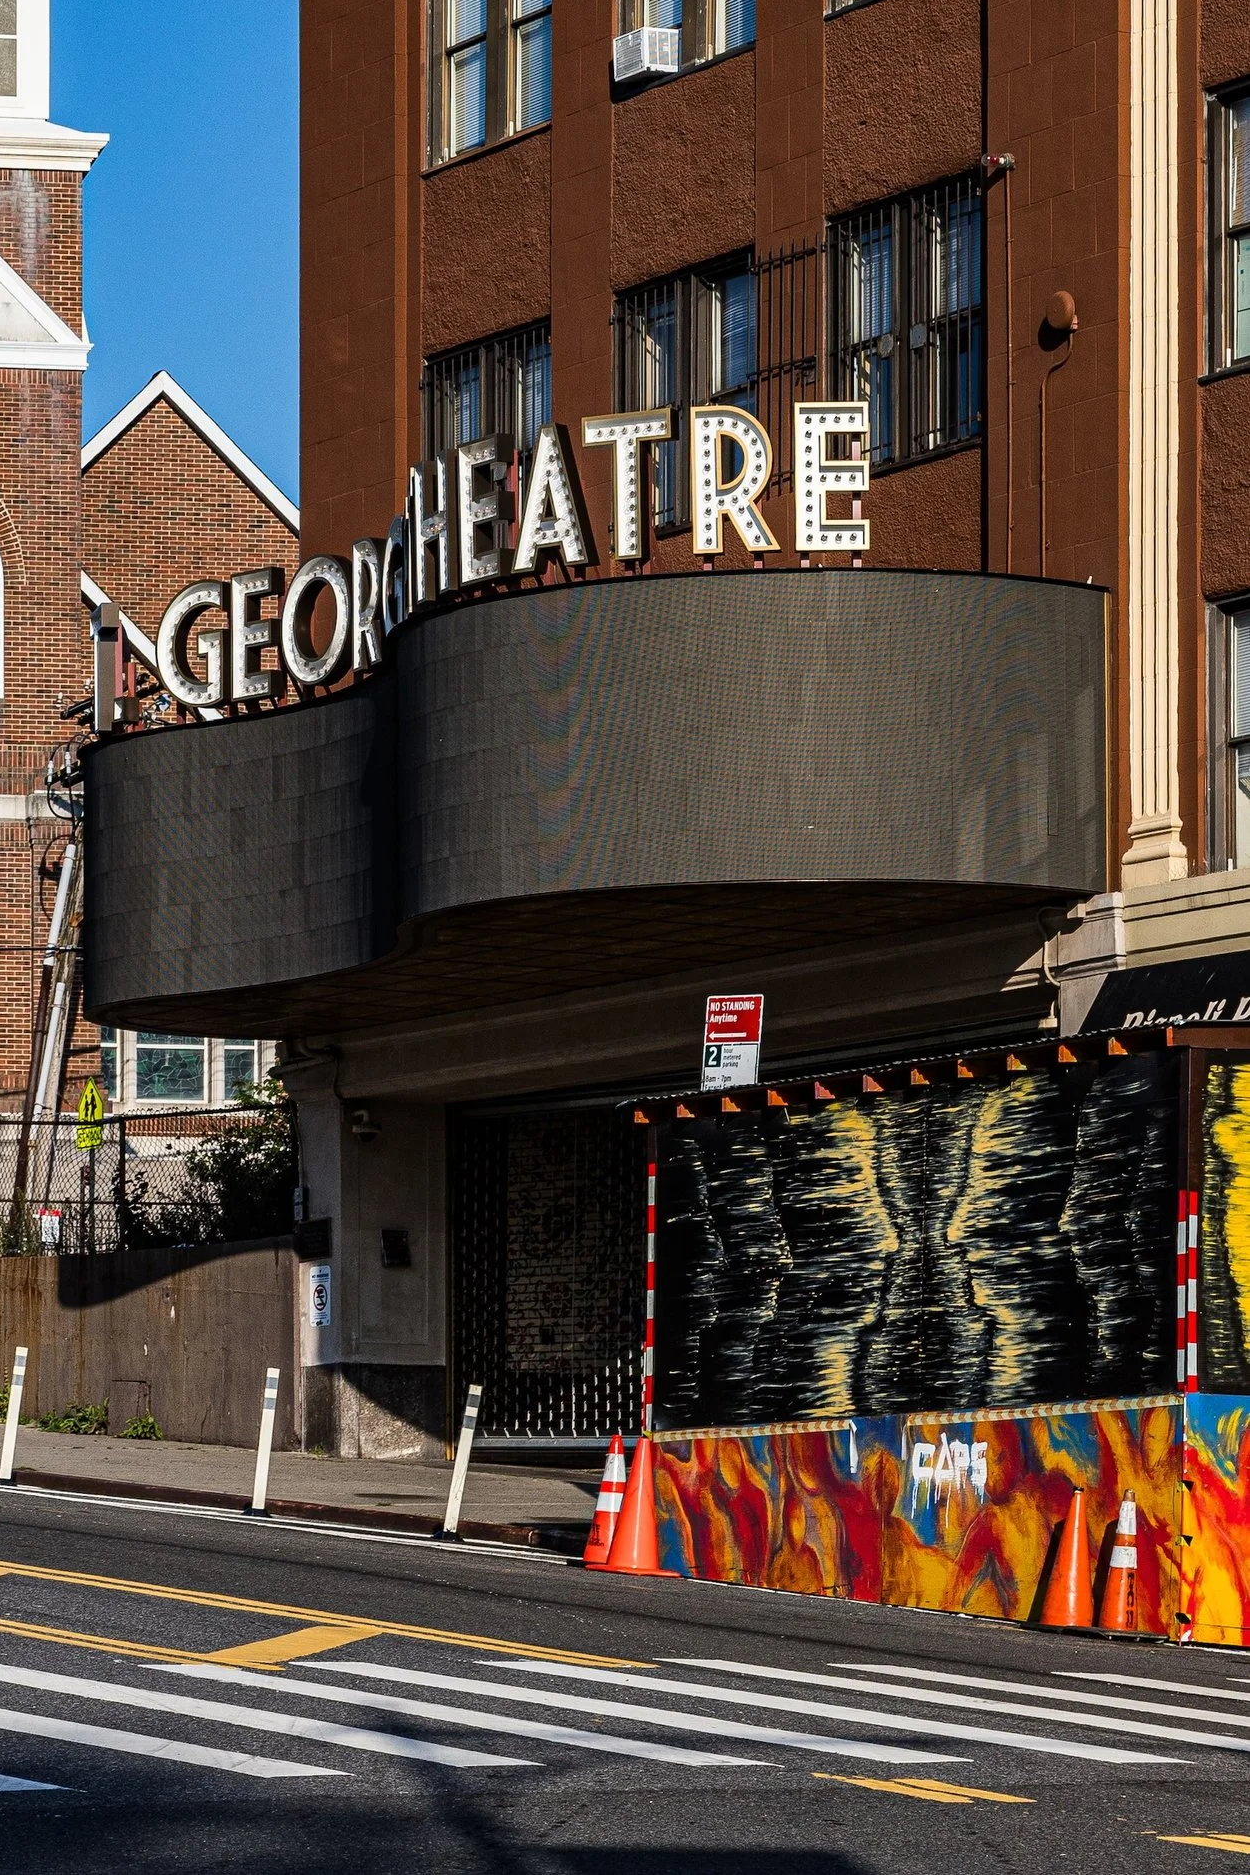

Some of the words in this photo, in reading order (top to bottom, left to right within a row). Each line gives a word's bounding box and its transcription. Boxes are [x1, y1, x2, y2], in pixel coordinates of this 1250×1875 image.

[710, 1002, 720, 1012] NO
[722, 1001, 755, 1011] STANDING
[709, 1013, 738, 1024] Anytime
[707, 1046, 718, 1066] 2
[722, 1061, 739, 1069] parking
